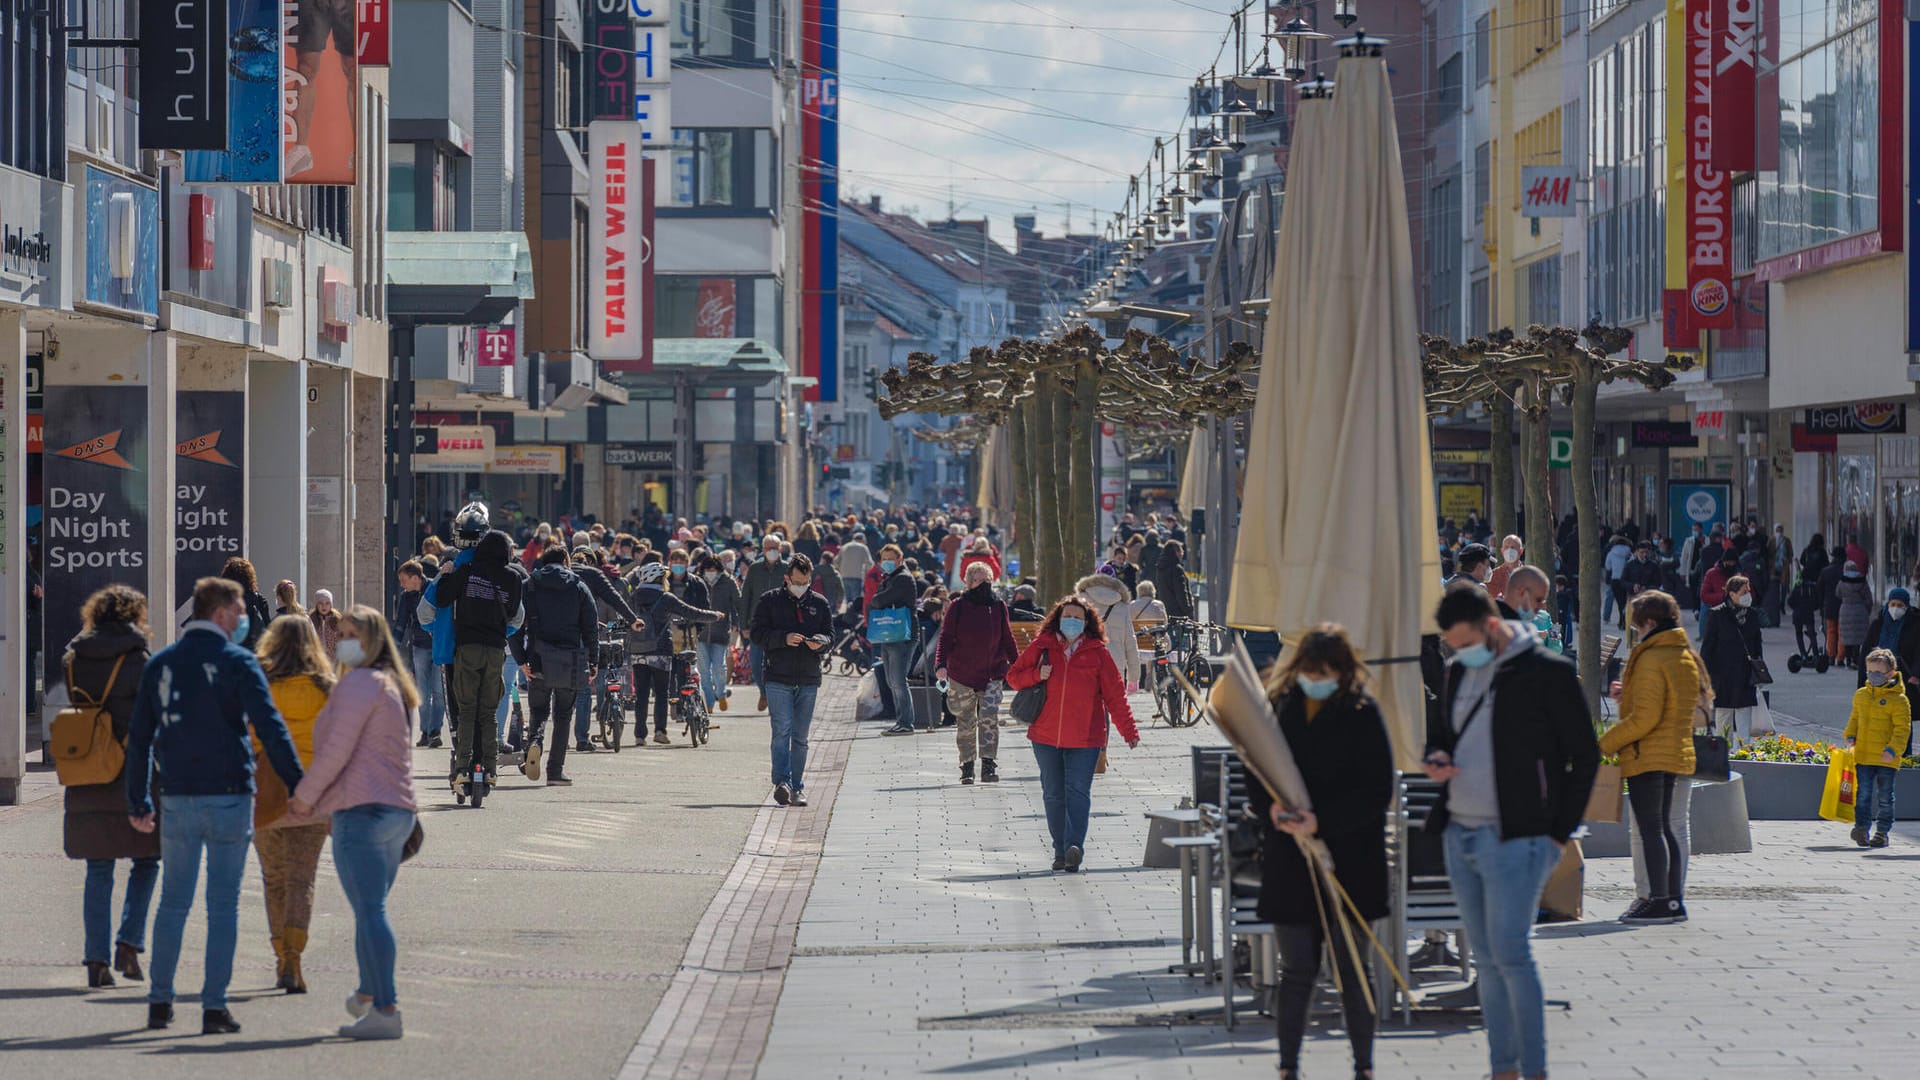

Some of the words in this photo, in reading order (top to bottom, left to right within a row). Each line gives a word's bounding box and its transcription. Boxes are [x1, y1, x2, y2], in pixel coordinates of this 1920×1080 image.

[1527, 176, 1571, 206] H&M
[606, 246, 625, 338] TALLY
[486, 334, 507, 360] T
[75, 438, 104, 457] DNS
[180, 437, 206, 454] DNS
[50, 487, 105, 514] Day
[177, 484, 206, 504] ay
[50, 517, 131, 543] Night
[177, 507, 228, 530] ight
[176, 535, 239, 552] ports
[50, 546, 143, 573] Sports
